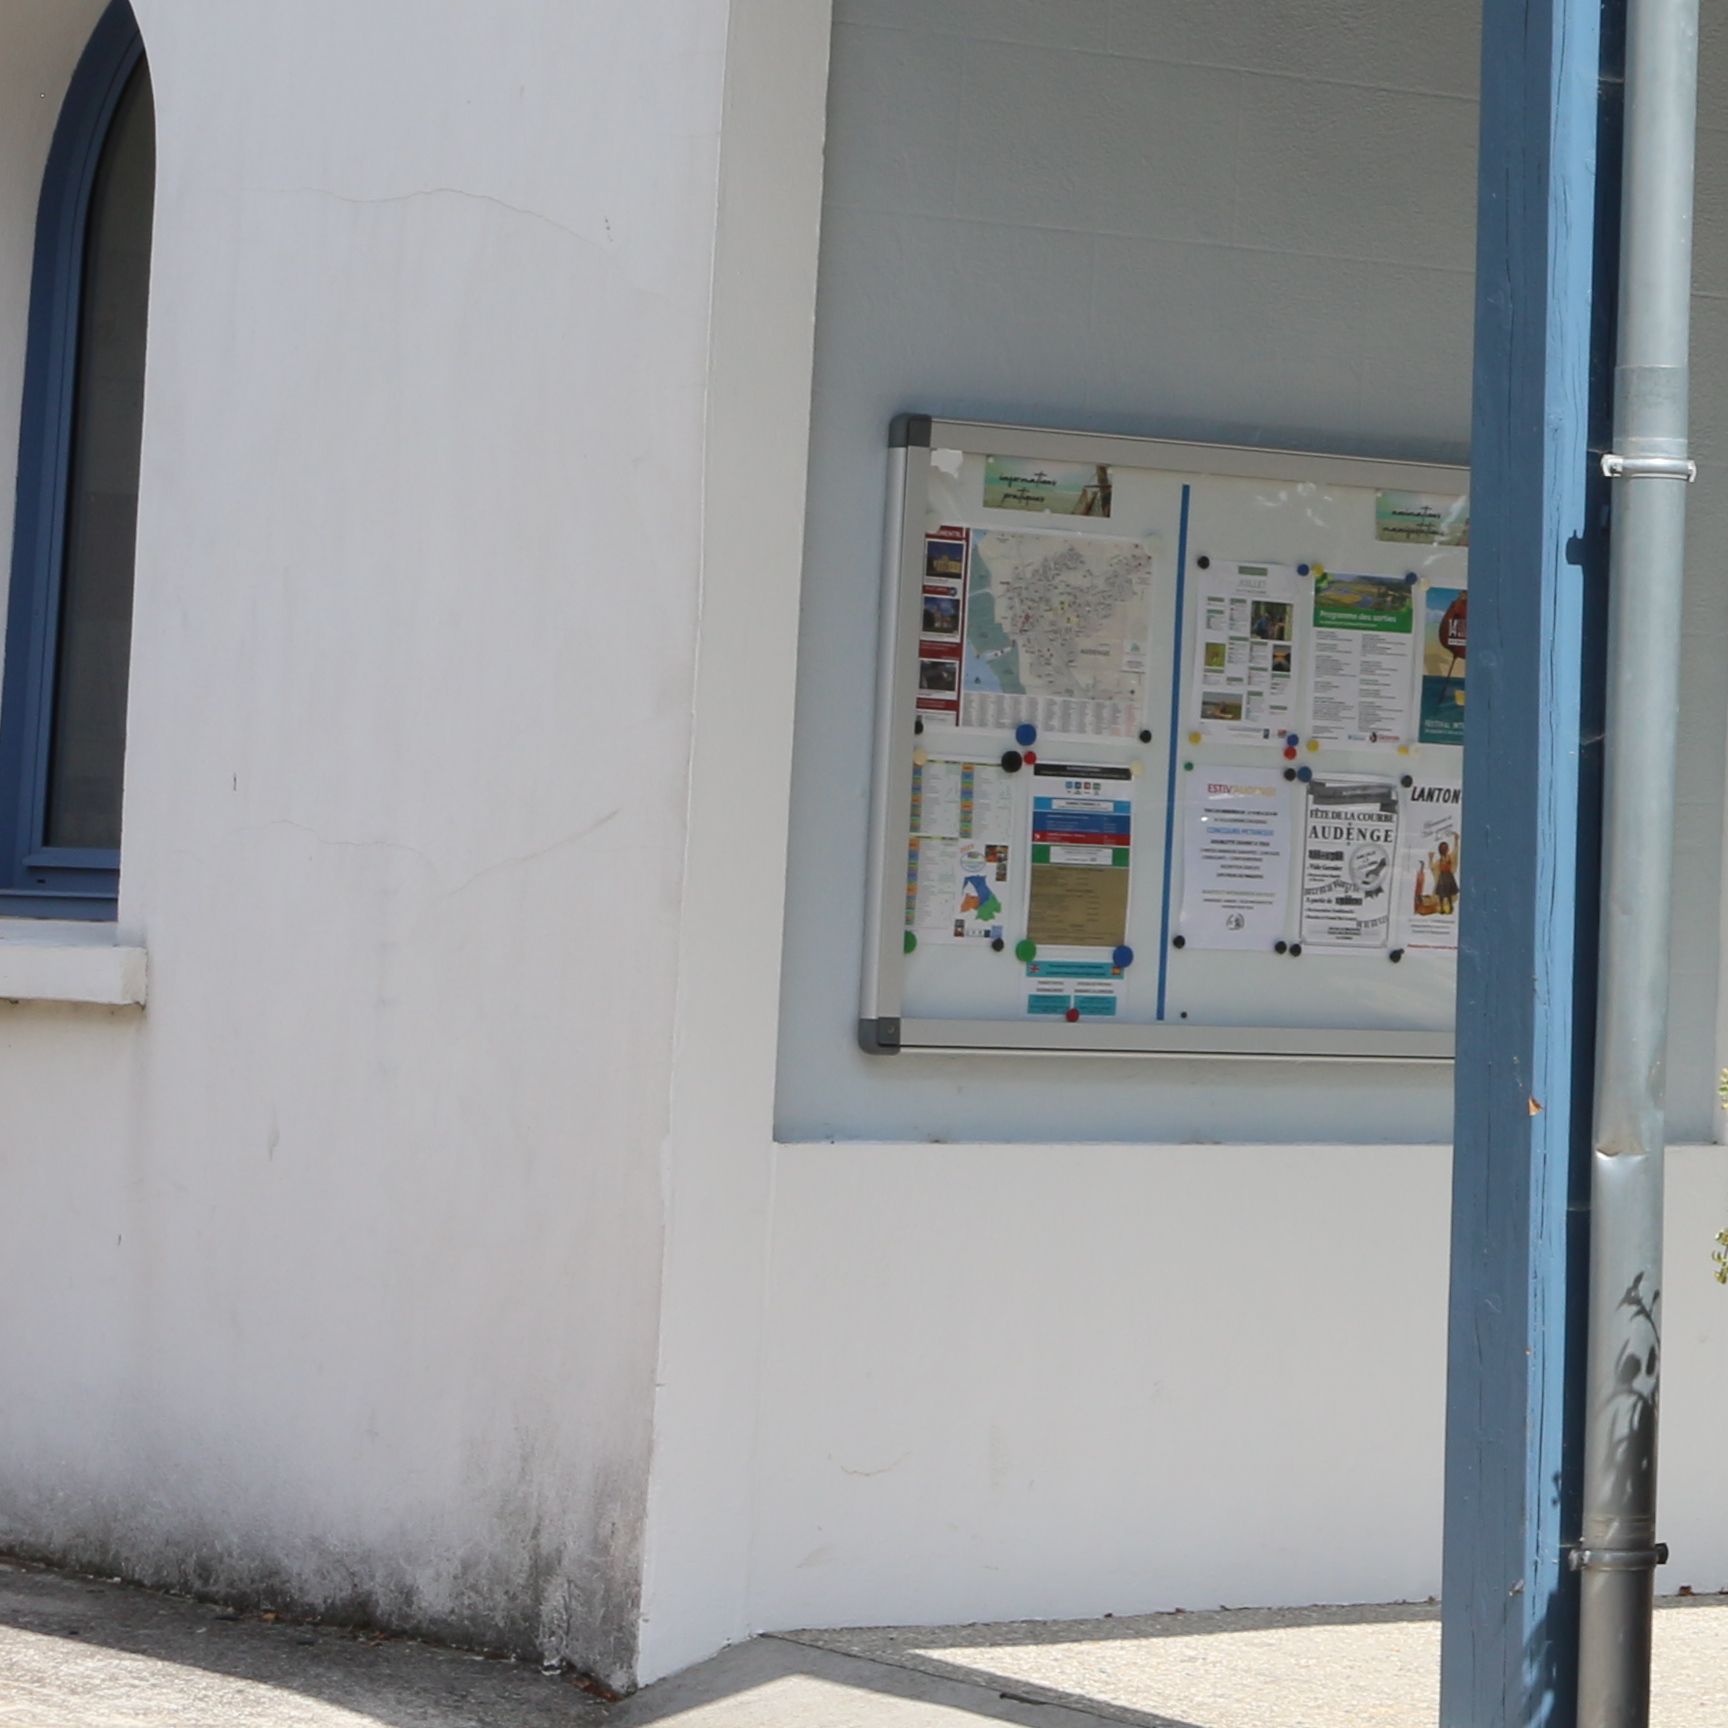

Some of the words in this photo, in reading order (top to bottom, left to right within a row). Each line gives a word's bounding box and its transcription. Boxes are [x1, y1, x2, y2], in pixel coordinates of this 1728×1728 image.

[1411, 786, 1461, 804] LANTON
[1331, 810, 1342, 821] DE
[1344, 811, 1355, 821] LA
[1308, 825, 1394, 844] AUDENGE
